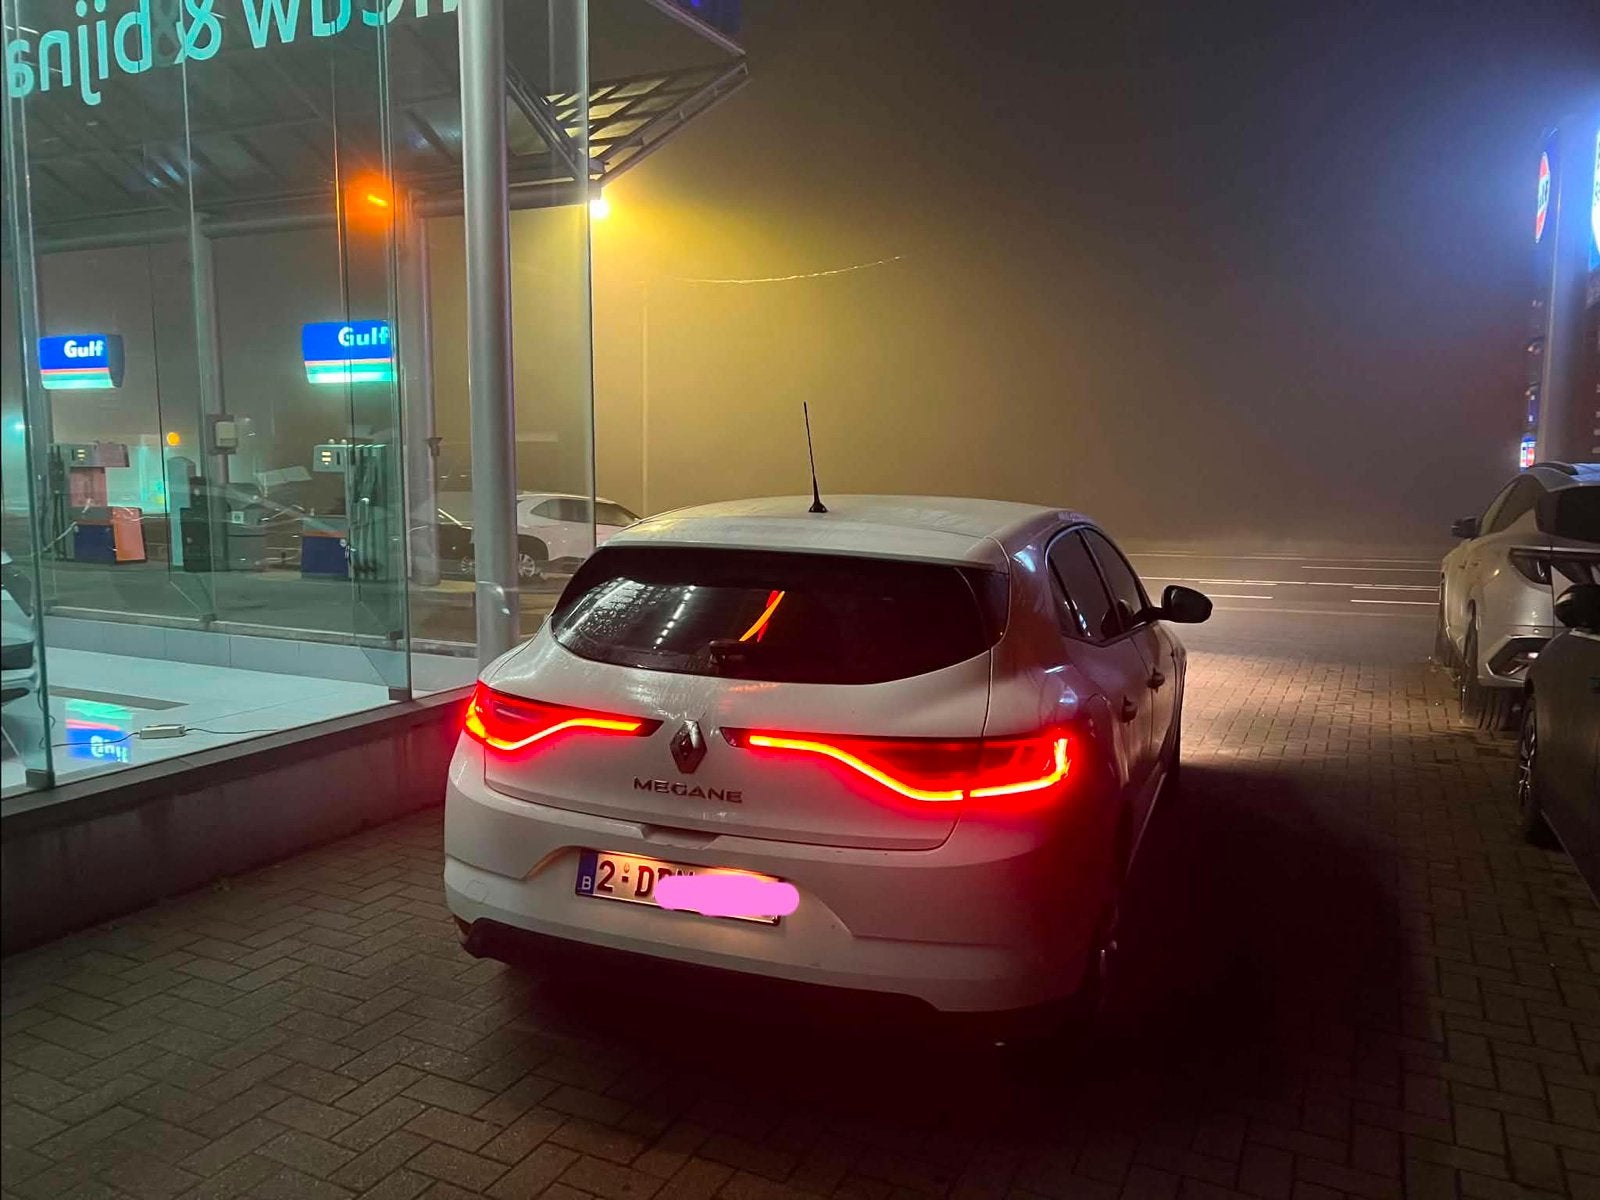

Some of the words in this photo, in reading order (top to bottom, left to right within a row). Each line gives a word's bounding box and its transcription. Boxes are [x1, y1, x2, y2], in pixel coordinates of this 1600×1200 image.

[337, 326, 389, 347] Gulf
[63, 339, 104, 358] Gulf
[633, 776, 743, 803] MEGANE
[581, 876, 592, 890] B
